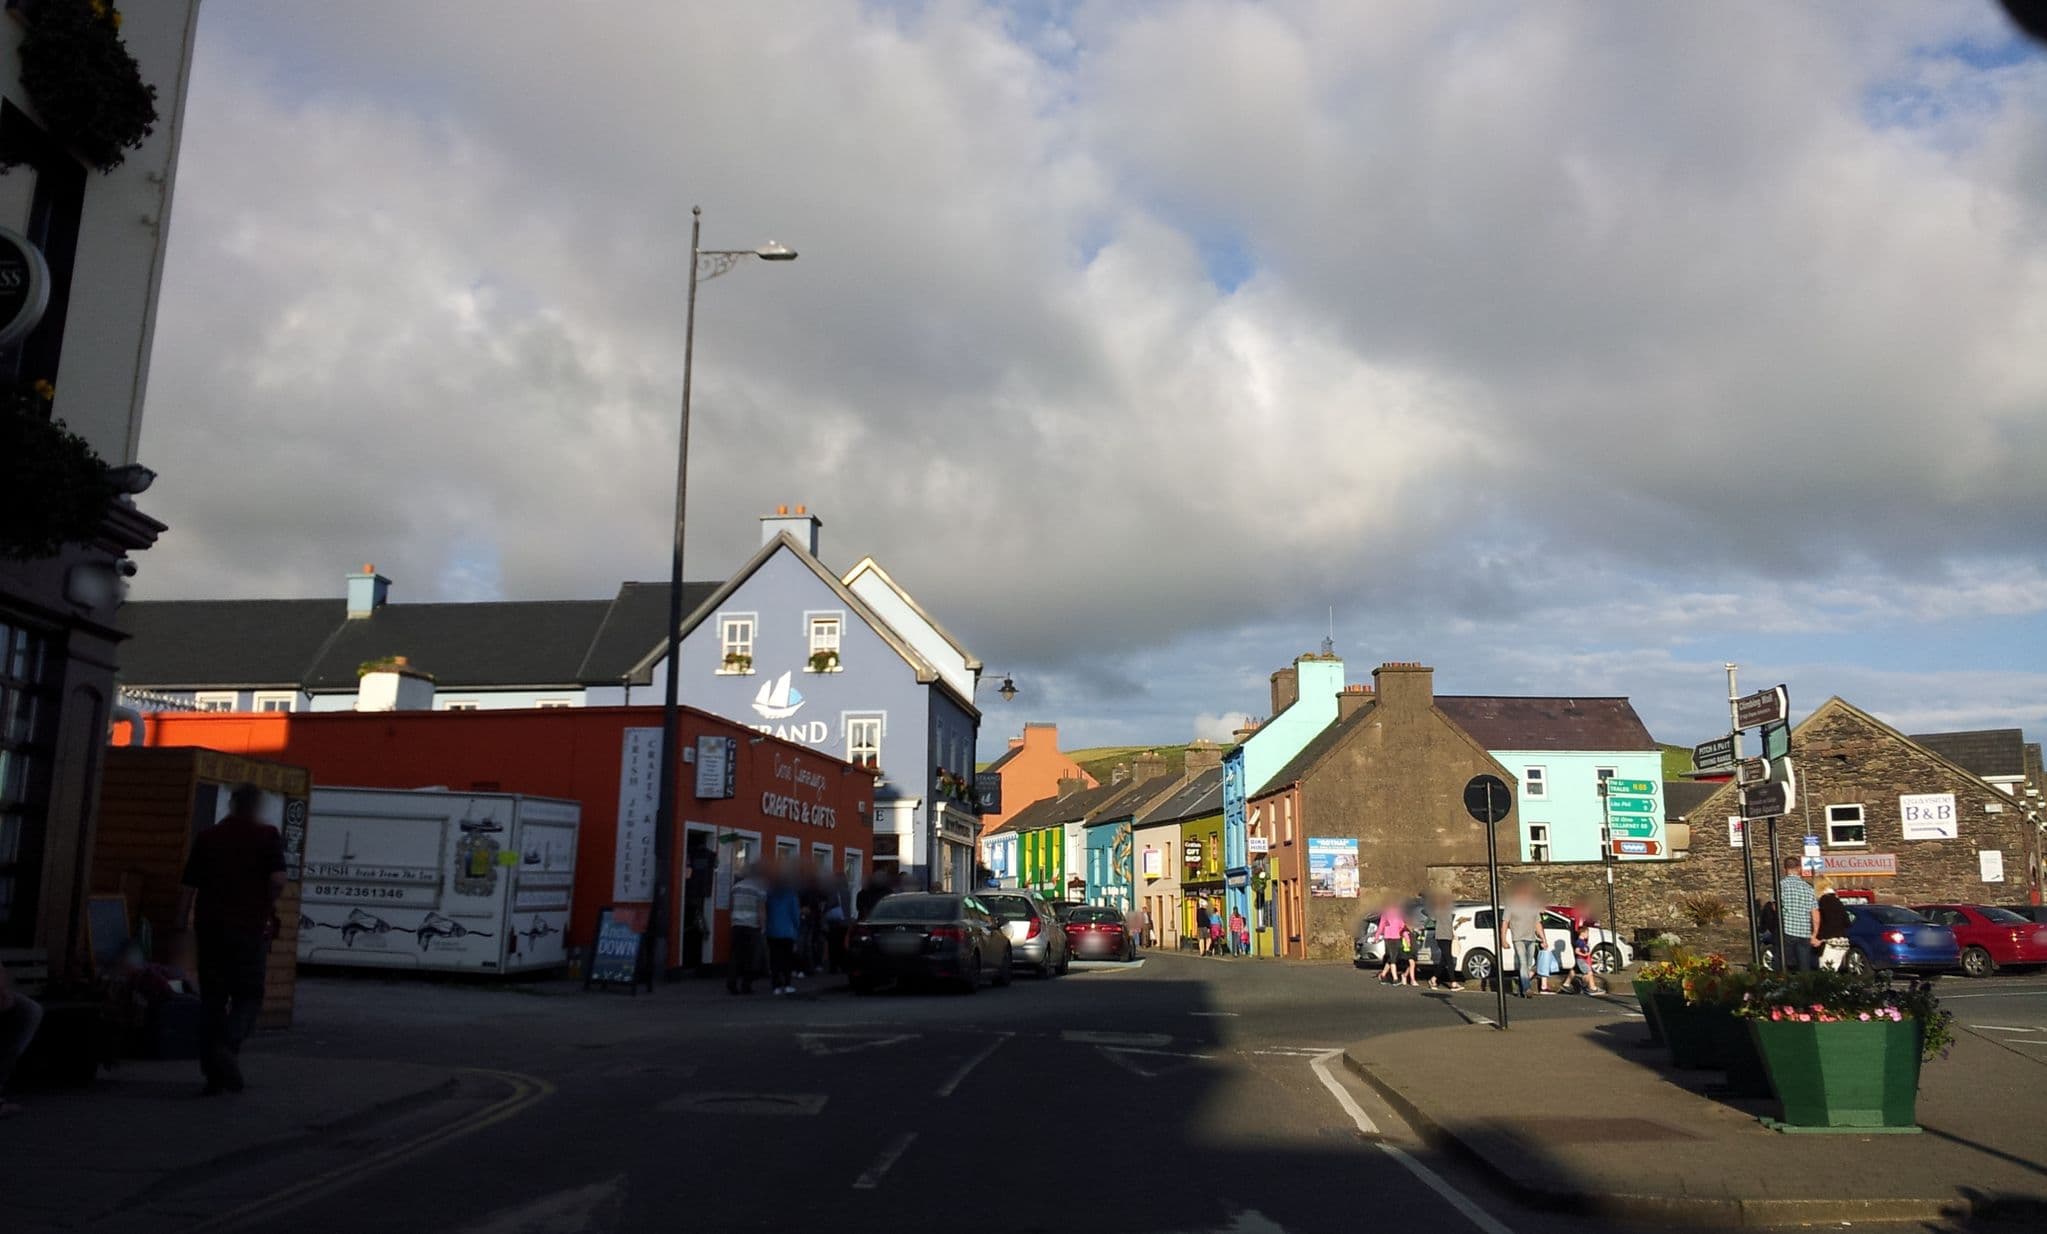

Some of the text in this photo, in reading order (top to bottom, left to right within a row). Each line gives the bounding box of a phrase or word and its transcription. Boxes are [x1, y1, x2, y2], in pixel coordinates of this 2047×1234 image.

[762, 792, 836, 829] CRAFTS & GIFTS
[1906, 804, 1951, 821] B & B
[1186, 848, 1200, 856] GIFT
